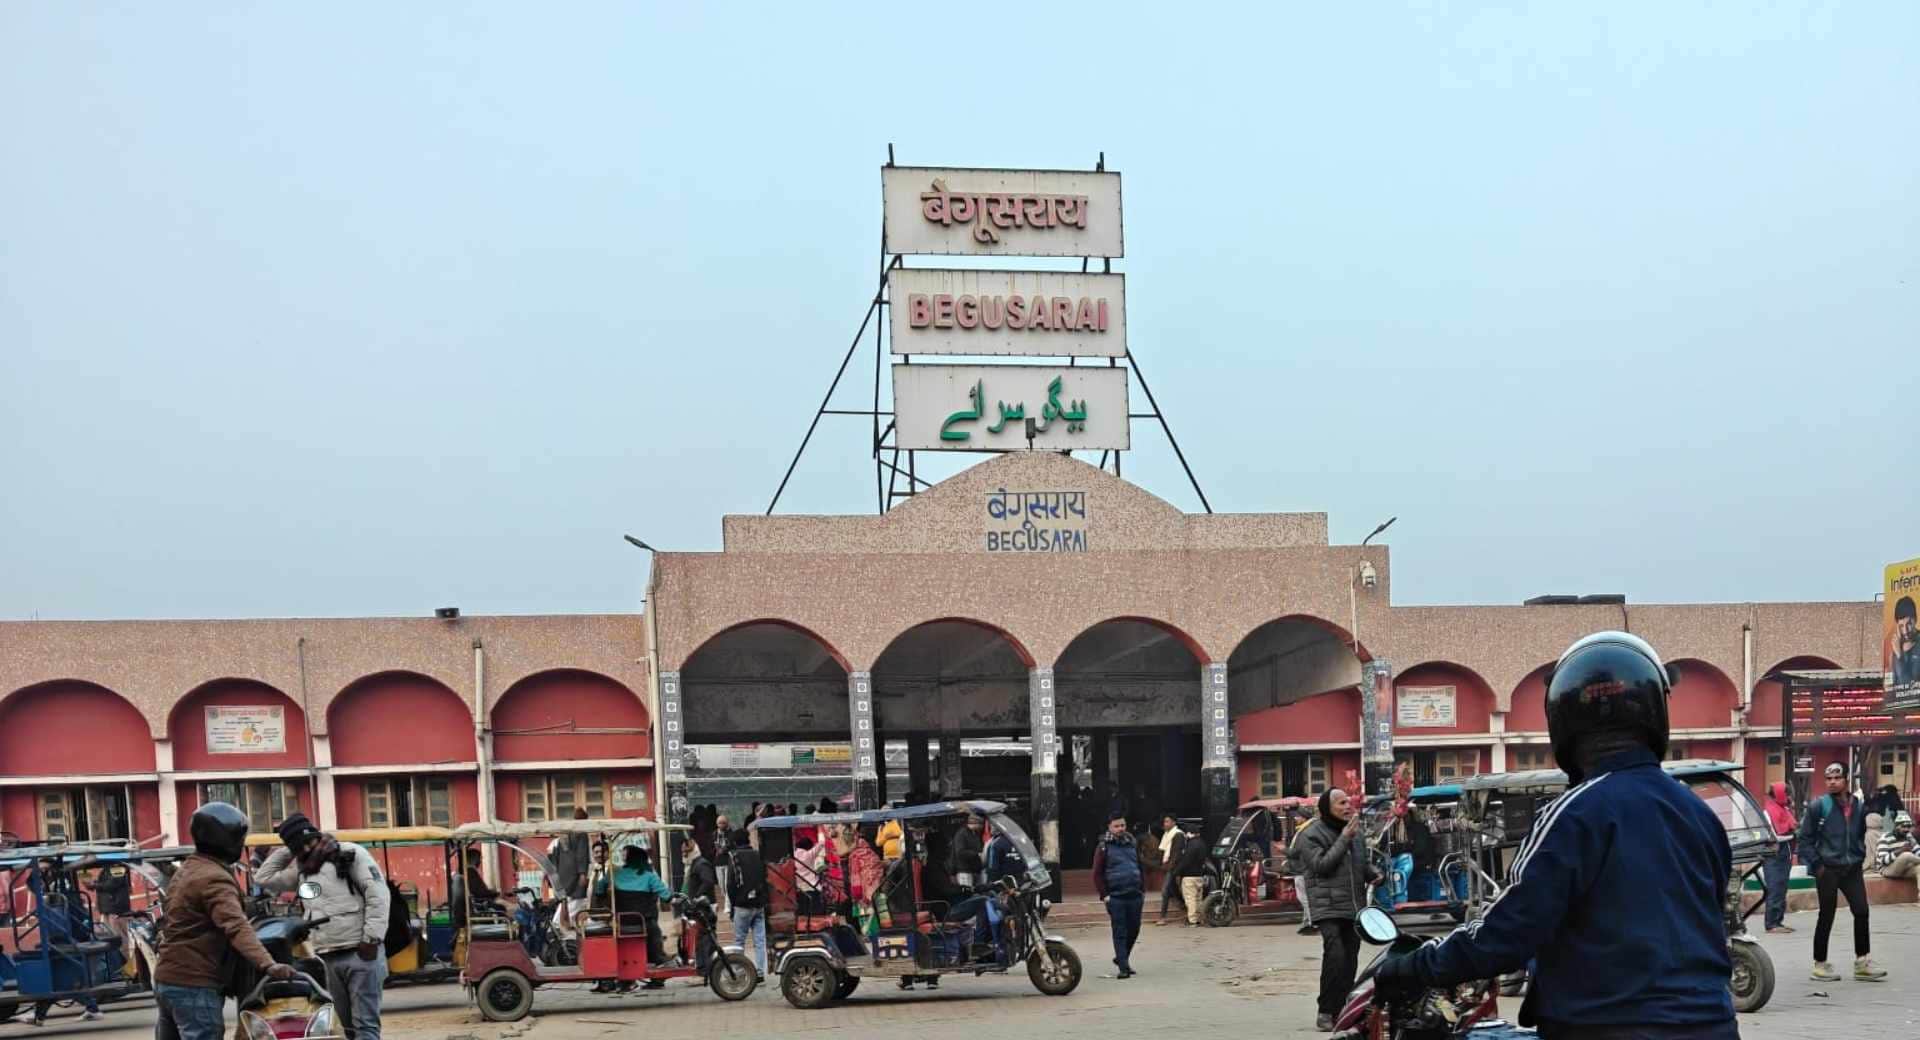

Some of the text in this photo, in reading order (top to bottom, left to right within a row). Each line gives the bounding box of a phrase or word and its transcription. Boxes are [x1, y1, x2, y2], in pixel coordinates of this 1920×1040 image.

[920, 178, 1089, 243] बेगूसराय
[909, 293, 1109, 332] BEGUSARAI
[987, 529, 1088, 552] BEGUSARAI
